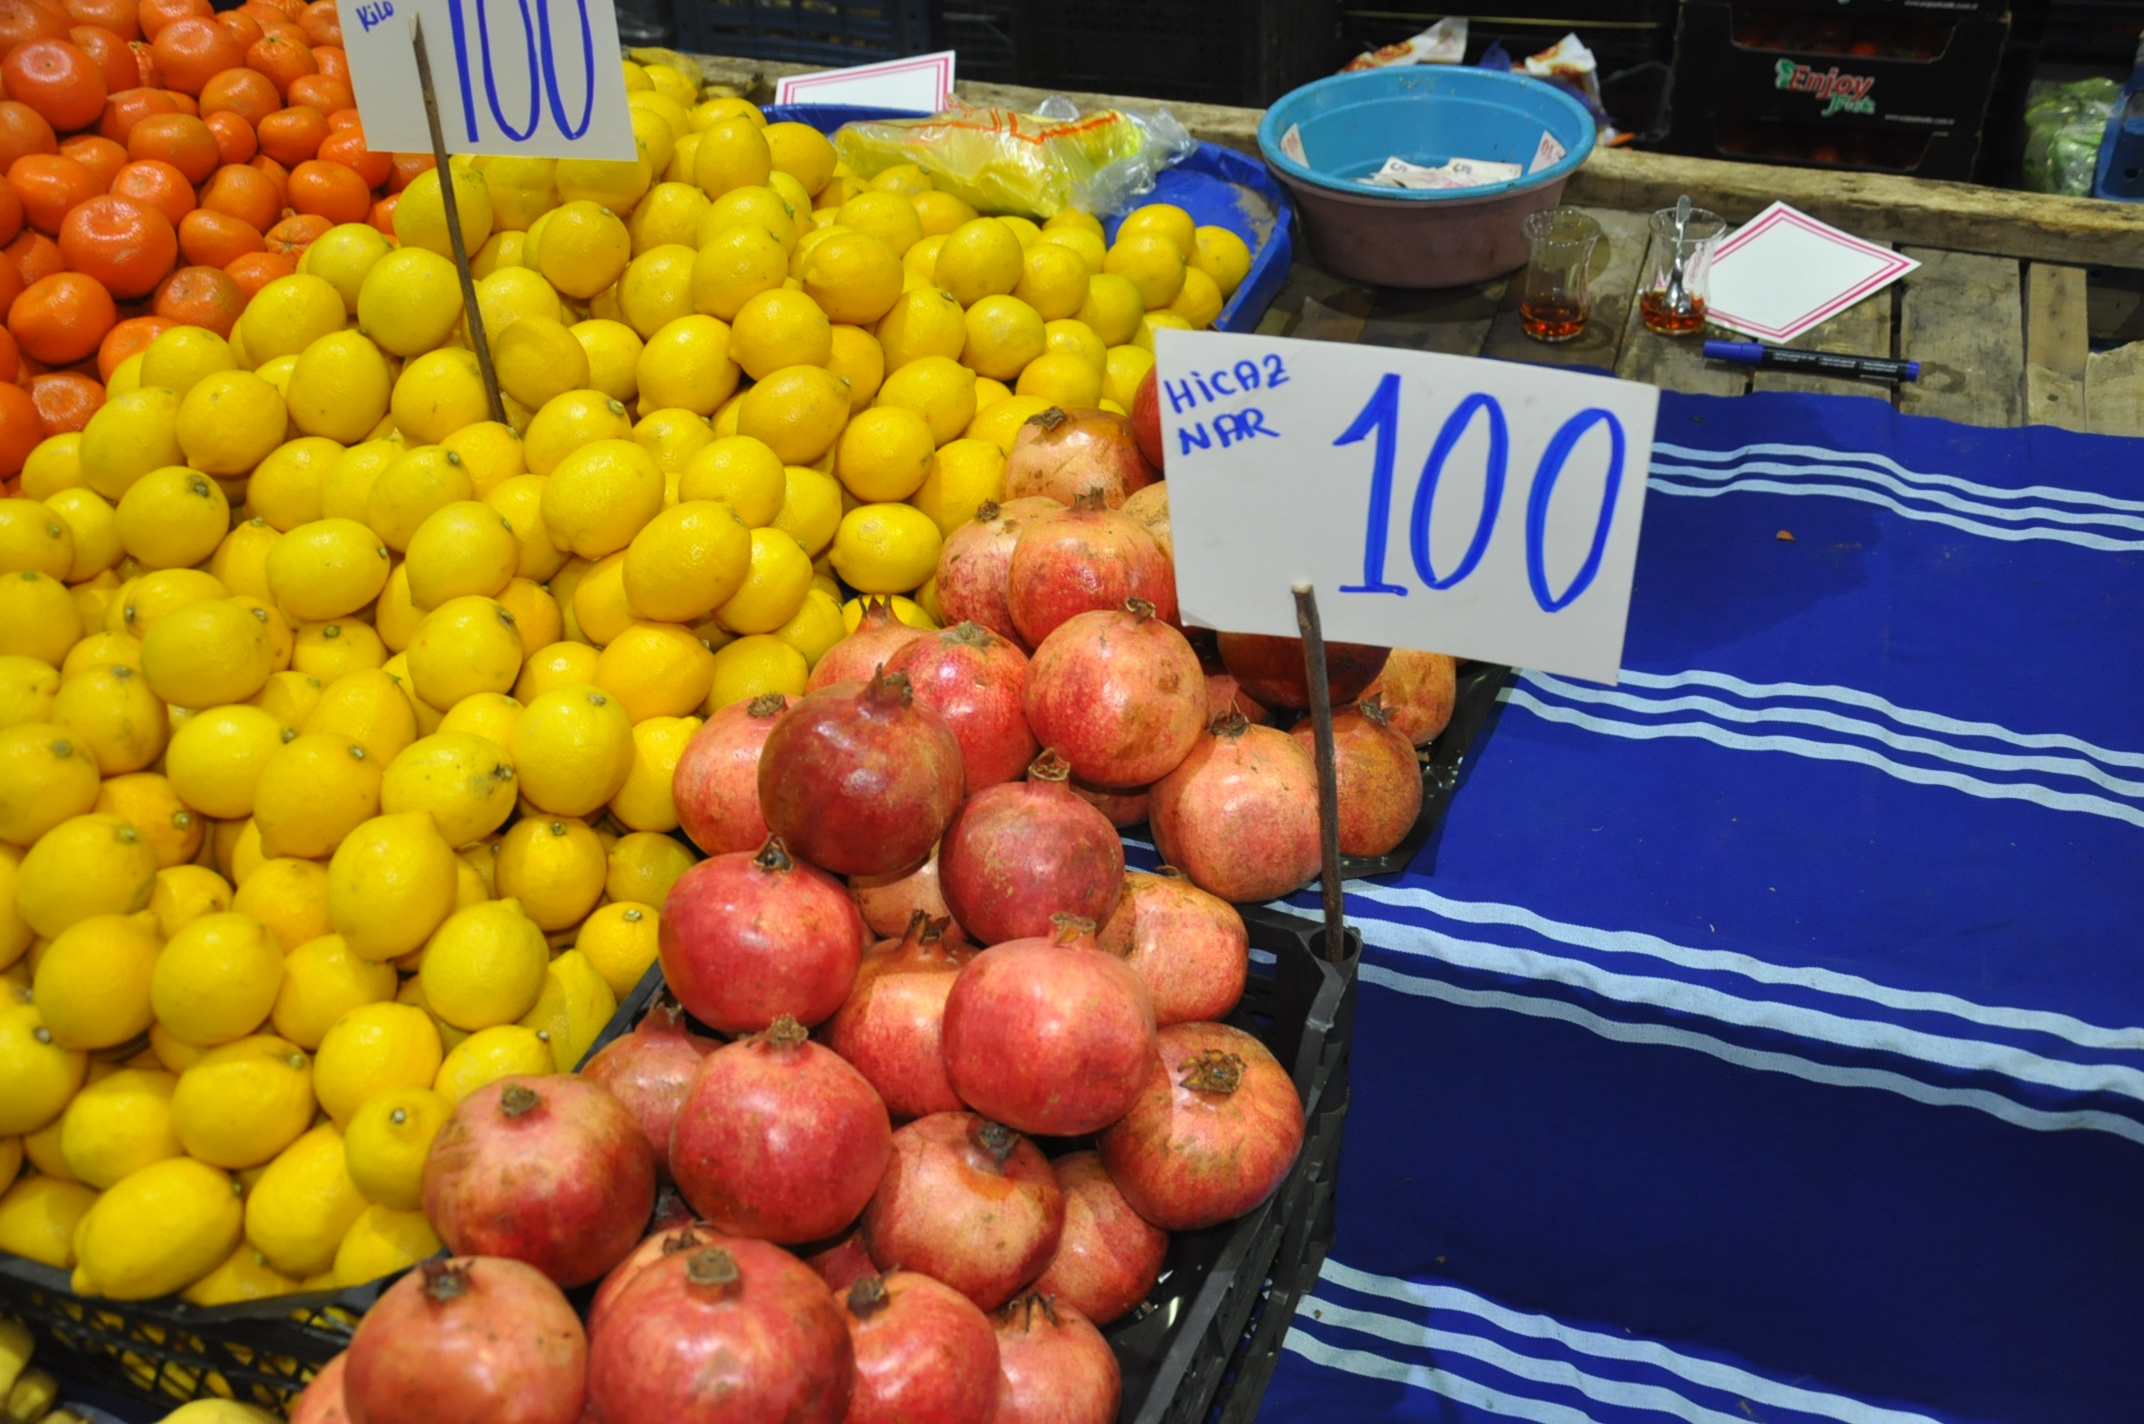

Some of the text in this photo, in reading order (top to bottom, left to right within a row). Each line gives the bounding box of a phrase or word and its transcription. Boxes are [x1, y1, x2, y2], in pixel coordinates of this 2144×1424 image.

[447, 0, 595, 143] 100
[1788, 64, 1875, 101] Enjoy
[1177, 406, 1281, 457] NAR
[1331, 371, 1628, 615] 100
